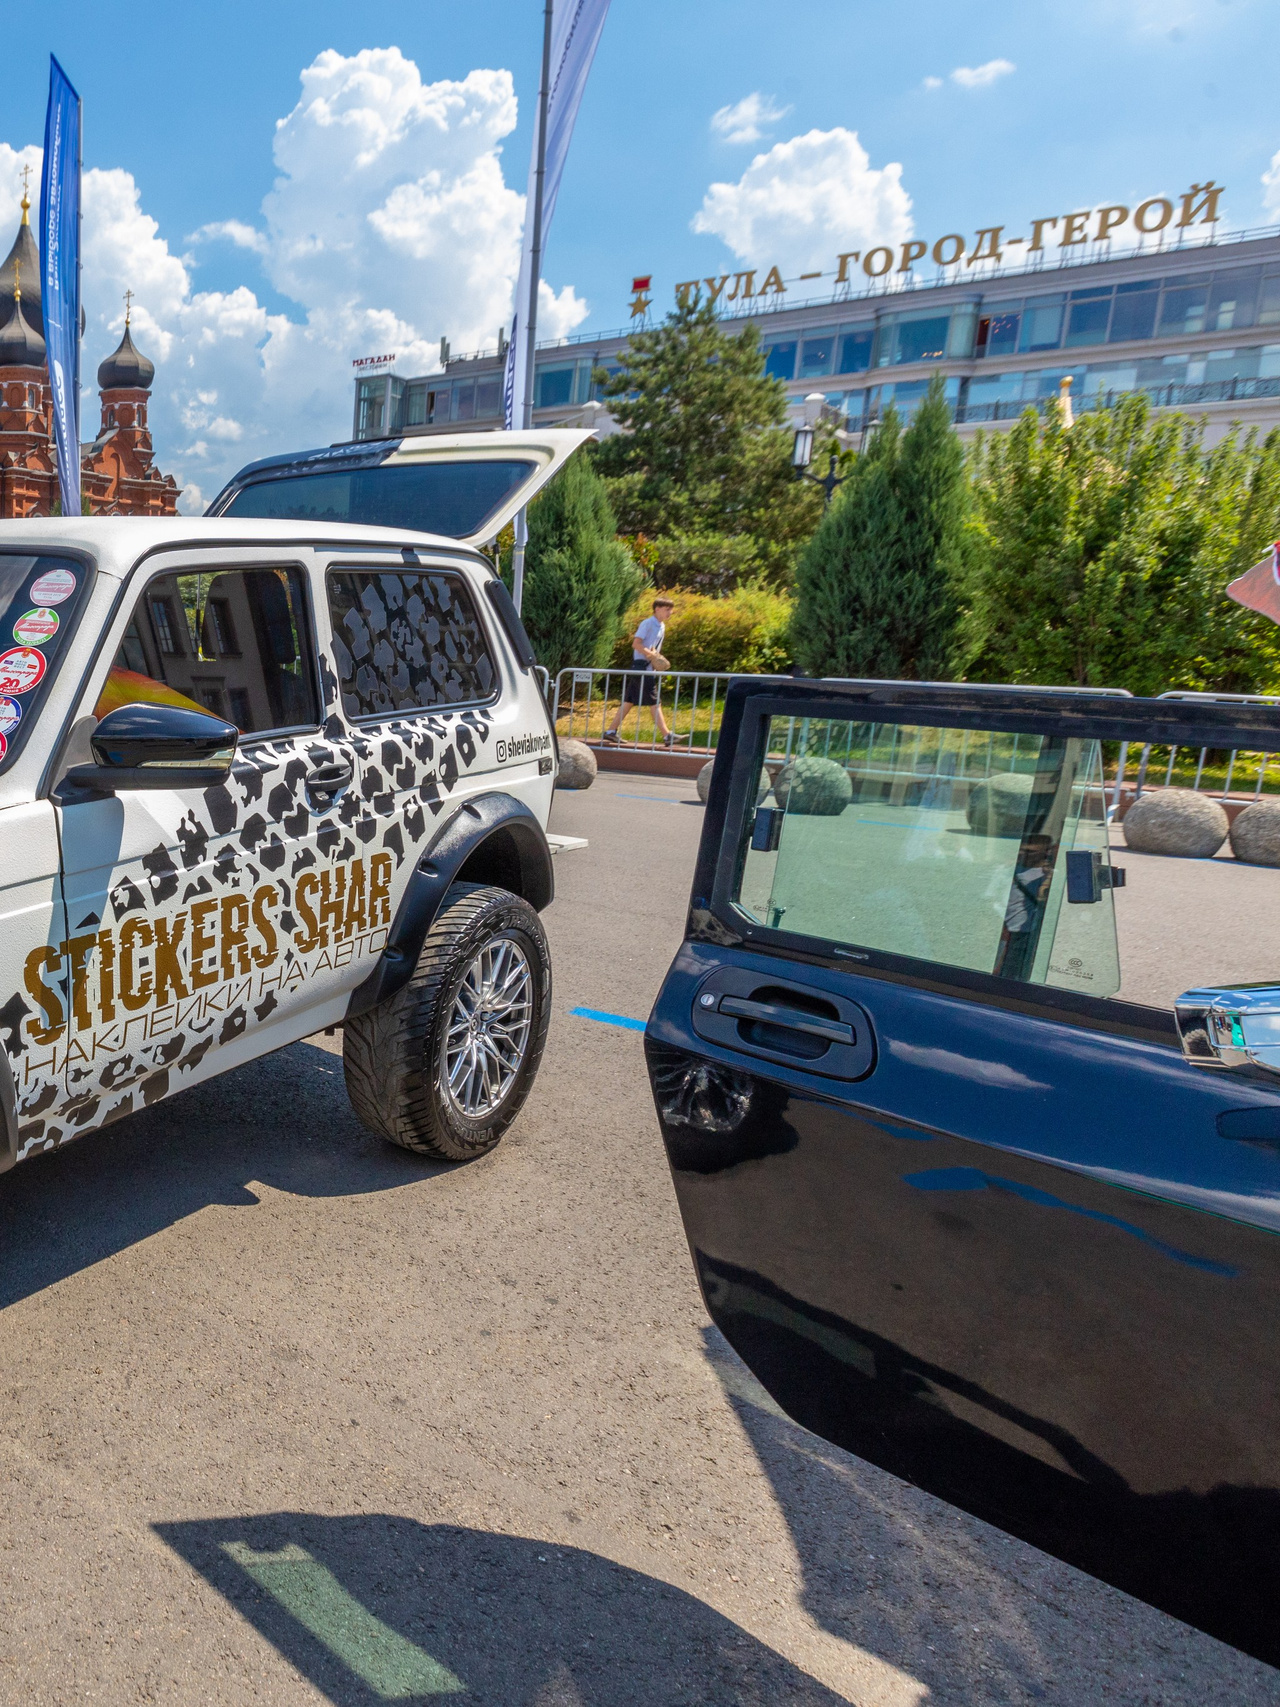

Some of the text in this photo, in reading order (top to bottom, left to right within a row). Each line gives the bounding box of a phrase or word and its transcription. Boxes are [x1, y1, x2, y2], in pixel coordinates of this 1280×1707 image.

[675, 266, 788, 306] ТУЛА
[835, 181, 1225, 284] ГОРОД-ГЕРОЙ
[23, 852, 393, 1046] STICKERS SHAR
[24, 927, 389, 1085] НАКЛЕЙКИ НА АВТО
